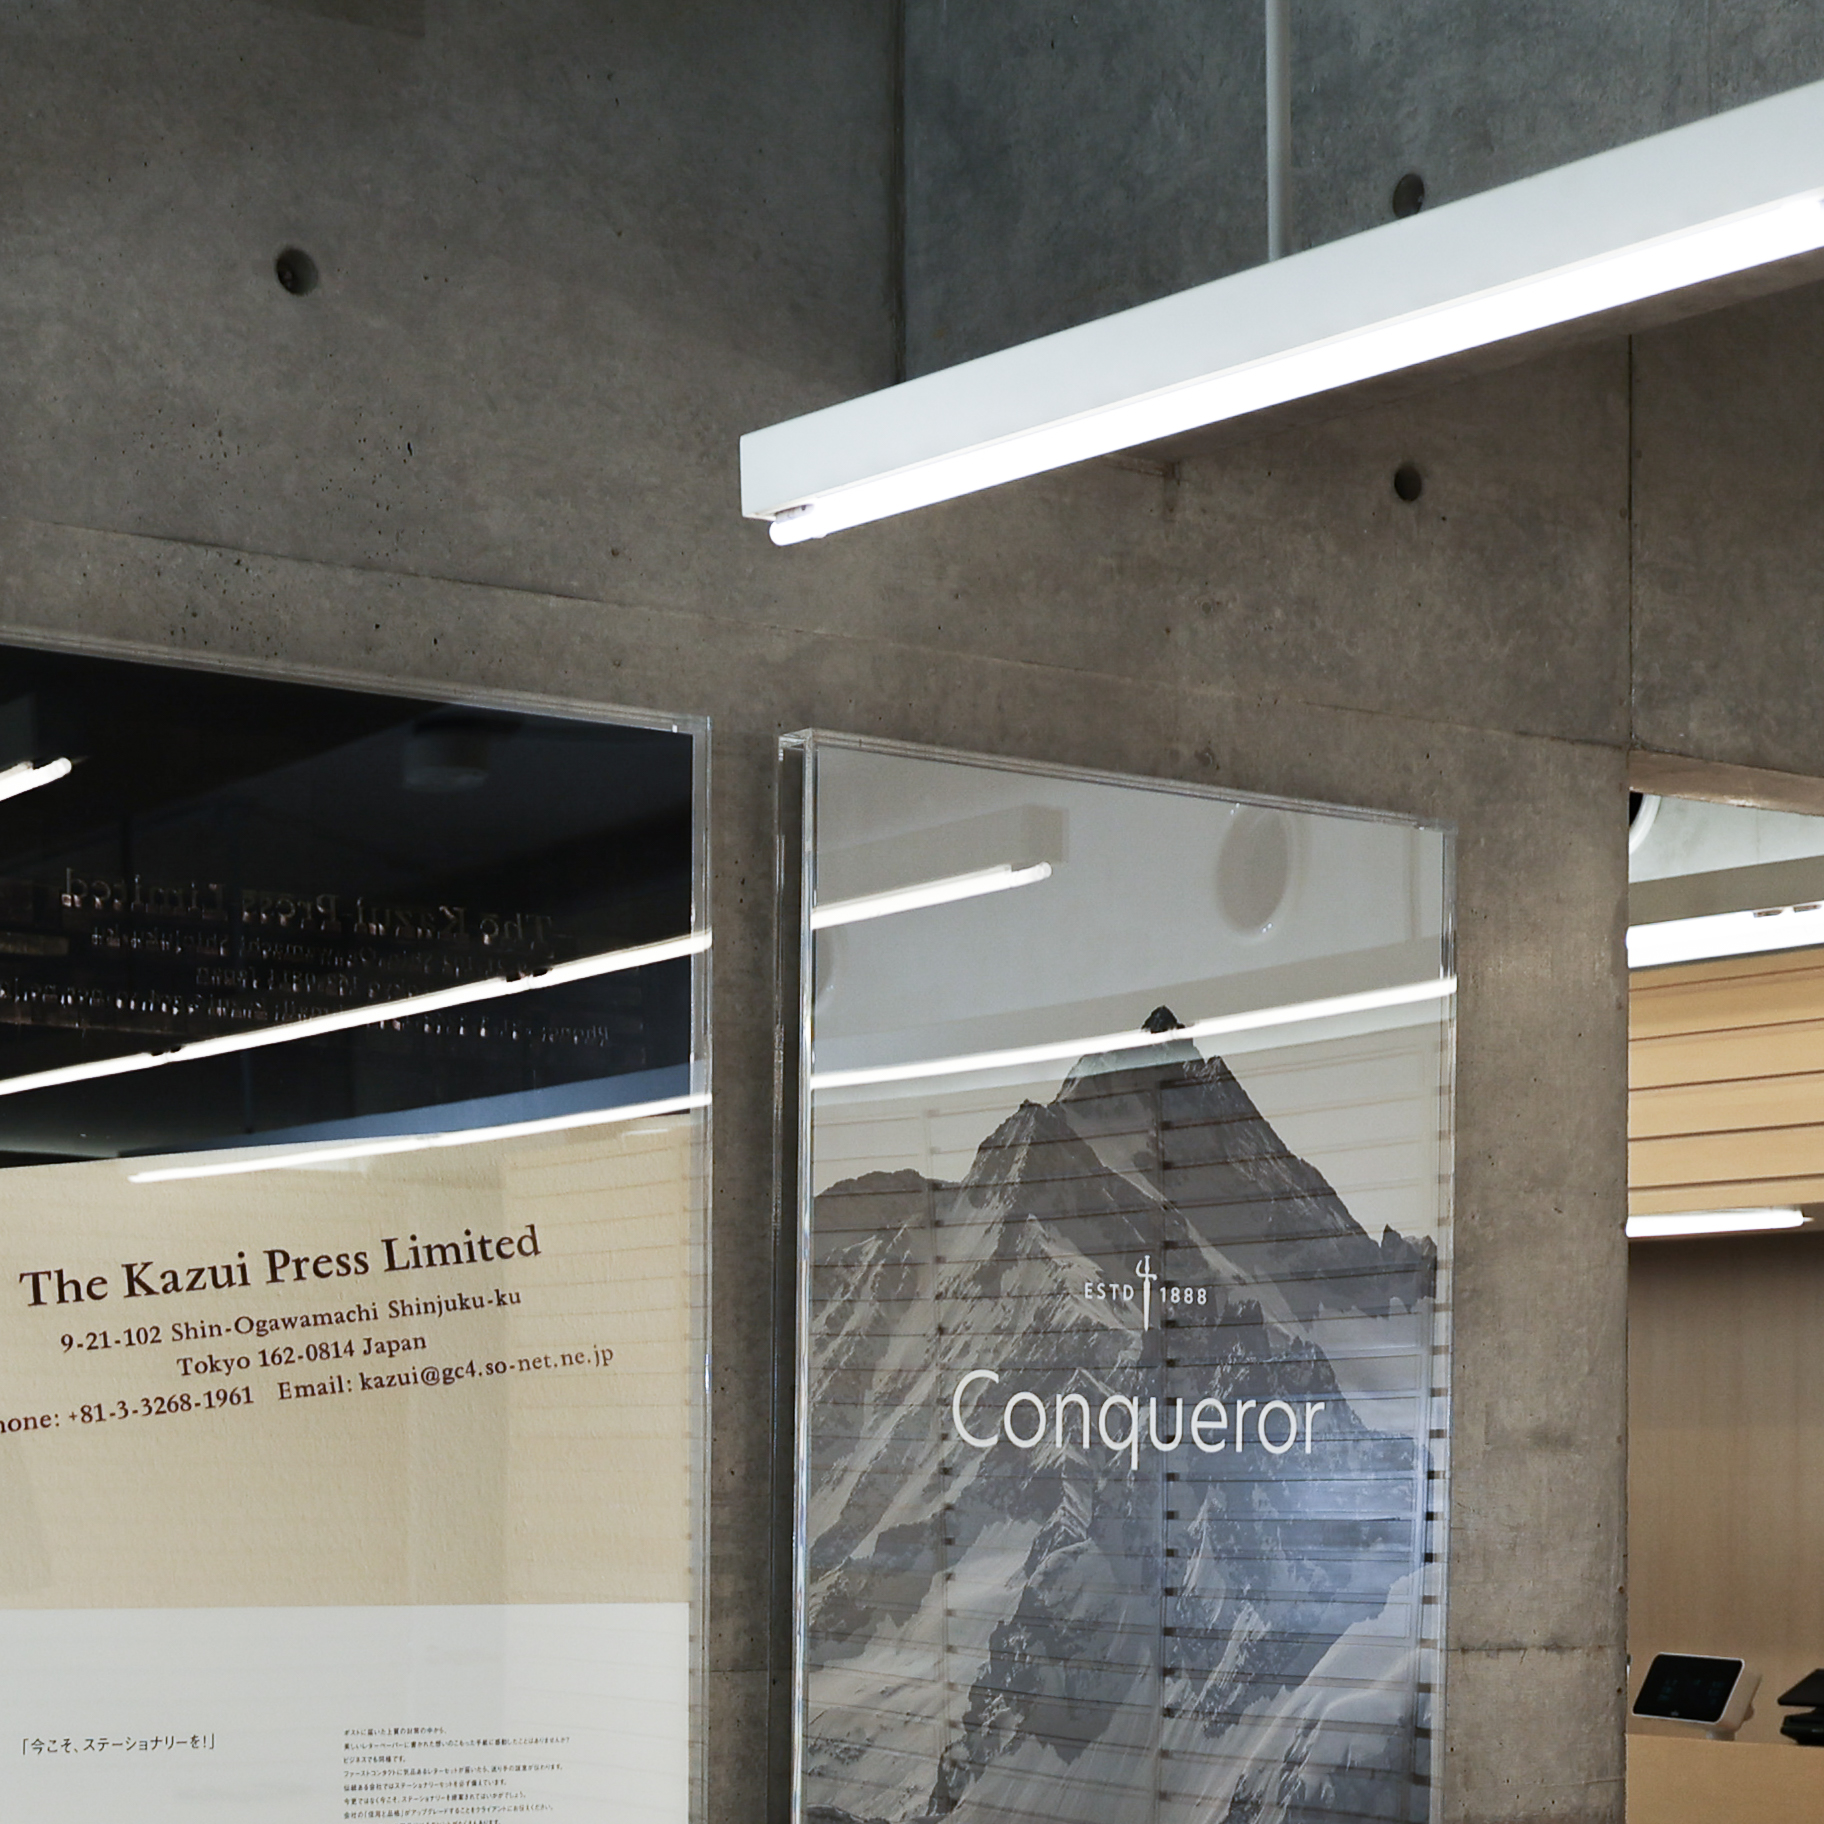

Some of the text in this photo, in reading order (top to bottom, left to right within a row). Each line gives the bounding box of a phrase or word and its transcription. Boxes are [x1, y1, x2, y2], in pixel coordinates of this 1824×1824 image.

[19, 1224, 541, 1307] The Kazui Press Limited
[1084, 1282, 1208, 1306] ESTD 1888
[61, 1289, 521, 1353] 9-21-102 Shin-Ogawamachi Shinjuku-ku
[177, 1336, 426, 1376] Tokyo 162-0814 Japan
[69, 1386, 254, 1423] +81-3-3268-1961
[277, 1375, 352, 1400] Email:
[359, 1344, 613, 1391] kazui@gc4.so-net.ne.jp
[952, 1369, 1324, 1470] Conqueror
